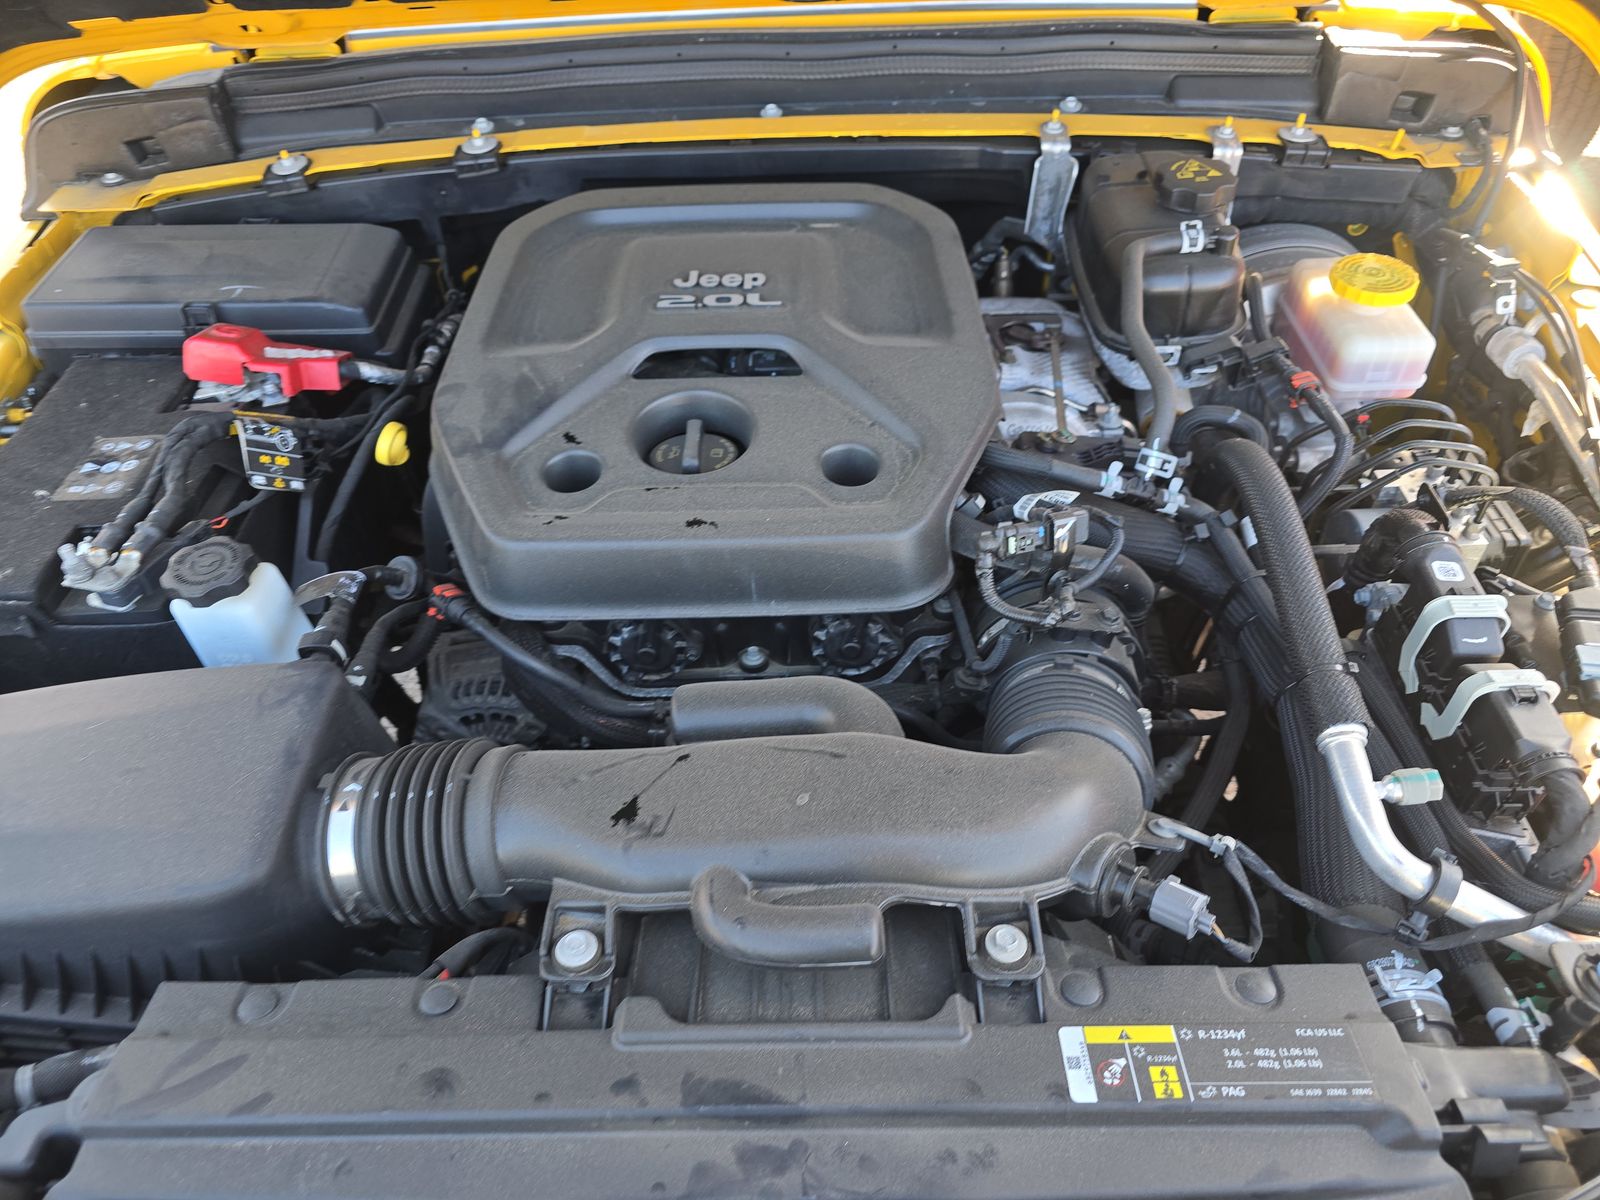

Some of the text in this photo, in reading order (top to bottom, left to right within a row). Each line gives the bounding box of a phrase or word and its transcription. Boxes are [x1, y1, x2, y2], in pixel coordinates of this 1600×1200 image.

[673, 270, 766, 290] Jeep
[656, 293, 783, 308] 2.0L
[1198, 1028, 1246, 1041] R-1234yf
[1295, 1028, 1345, 1037] FCA US LLC
[1222, 1048, 1243, 1057] 3.6L
[1226, 1059, 1247, 1068] 2.0L
[1221, 1086, 1246, 1097] PAG
